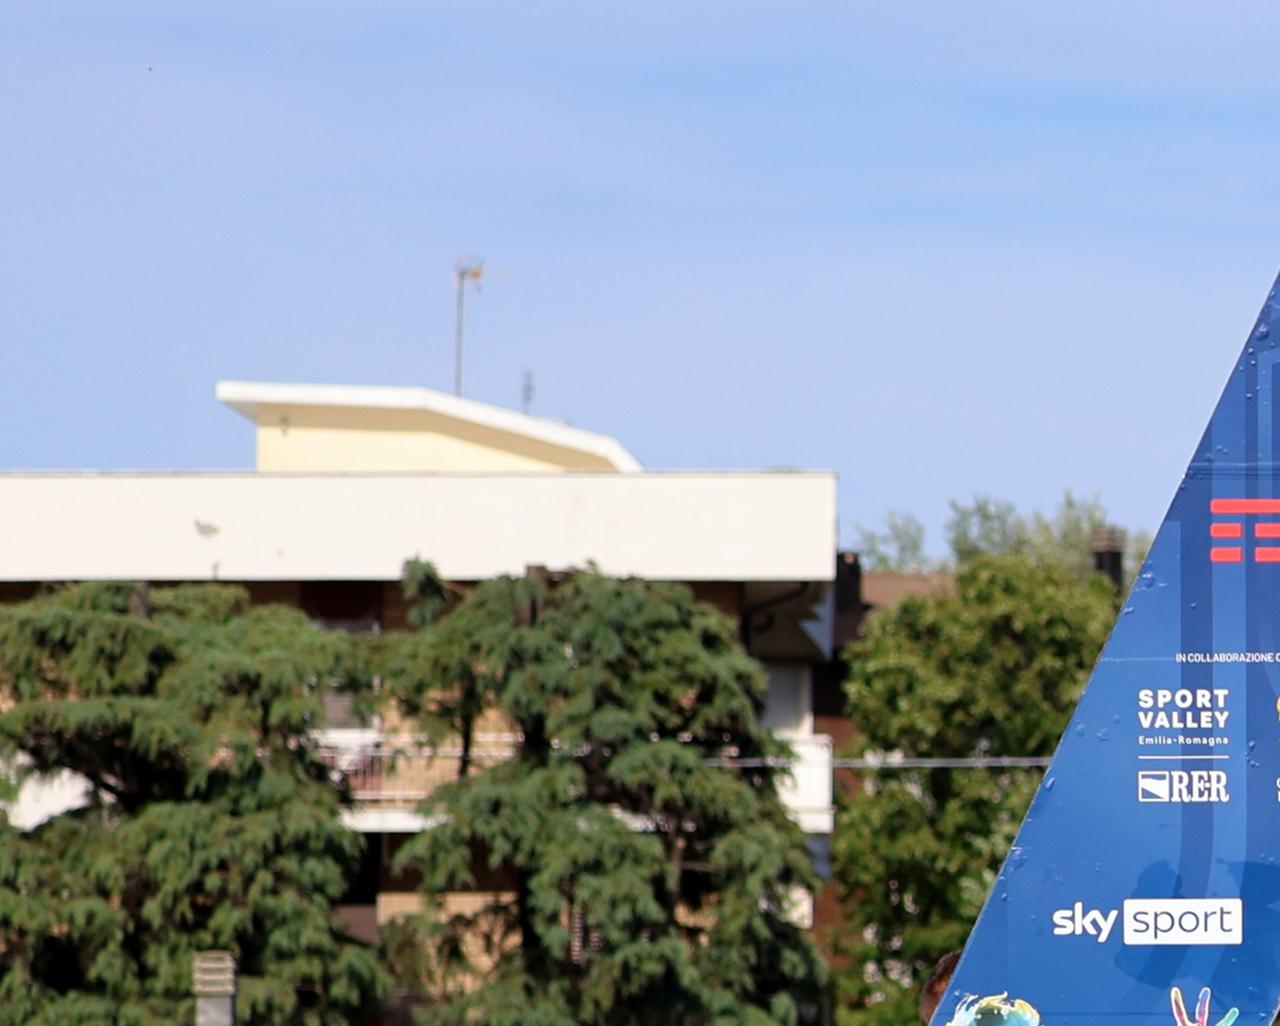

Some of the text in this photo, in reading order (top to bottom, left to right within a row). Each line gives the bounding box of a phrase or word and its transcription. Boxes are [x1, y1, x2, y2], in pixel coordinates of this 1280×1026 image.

[1175, 652, 1186, 663] IN
[1187, 652, 1274, 663] COLLABORAZIONE
[1138, 688, 1229, 708] SPORT
[1138, 711, 1229, 729] VALLEY
[1138, 735, 1229, 747] Emilia-Romagna
[1052, 901, 1233, 943] sky sport
